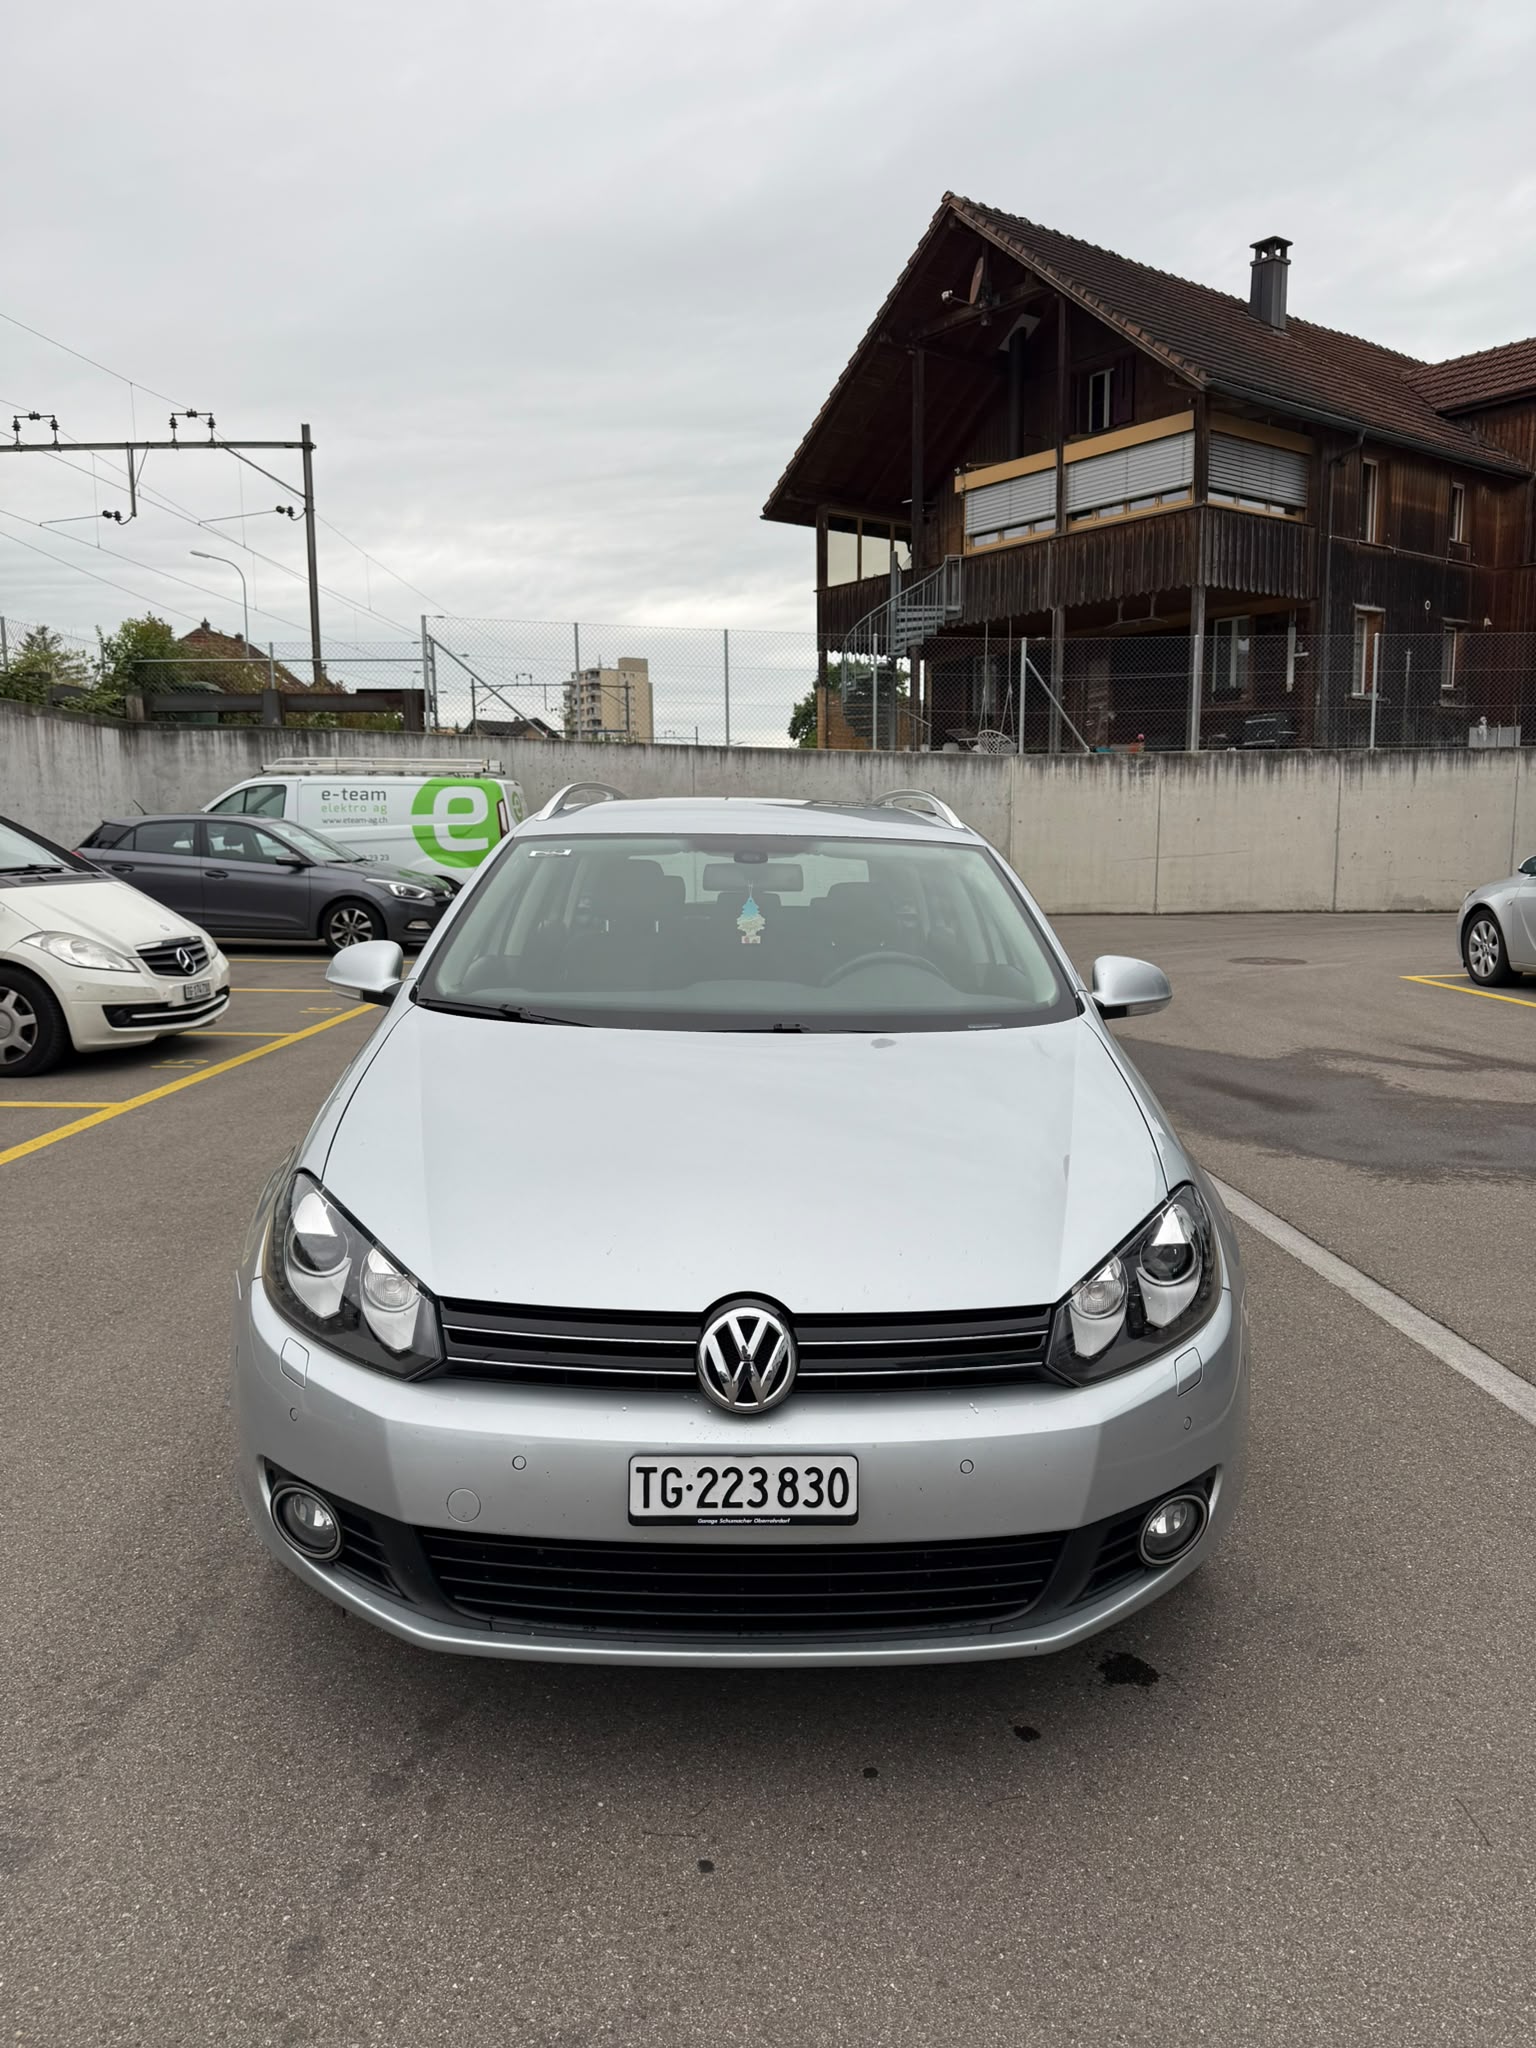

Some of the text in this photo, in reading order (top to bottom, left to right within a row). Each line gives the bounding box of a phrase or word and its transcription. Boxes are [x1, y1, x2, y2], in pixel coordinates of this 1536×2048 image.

[321, 788, 387, 801] e-team
[321, 803, 388, 815] elektro ag
[700, 1305, 796, 1412] VW
